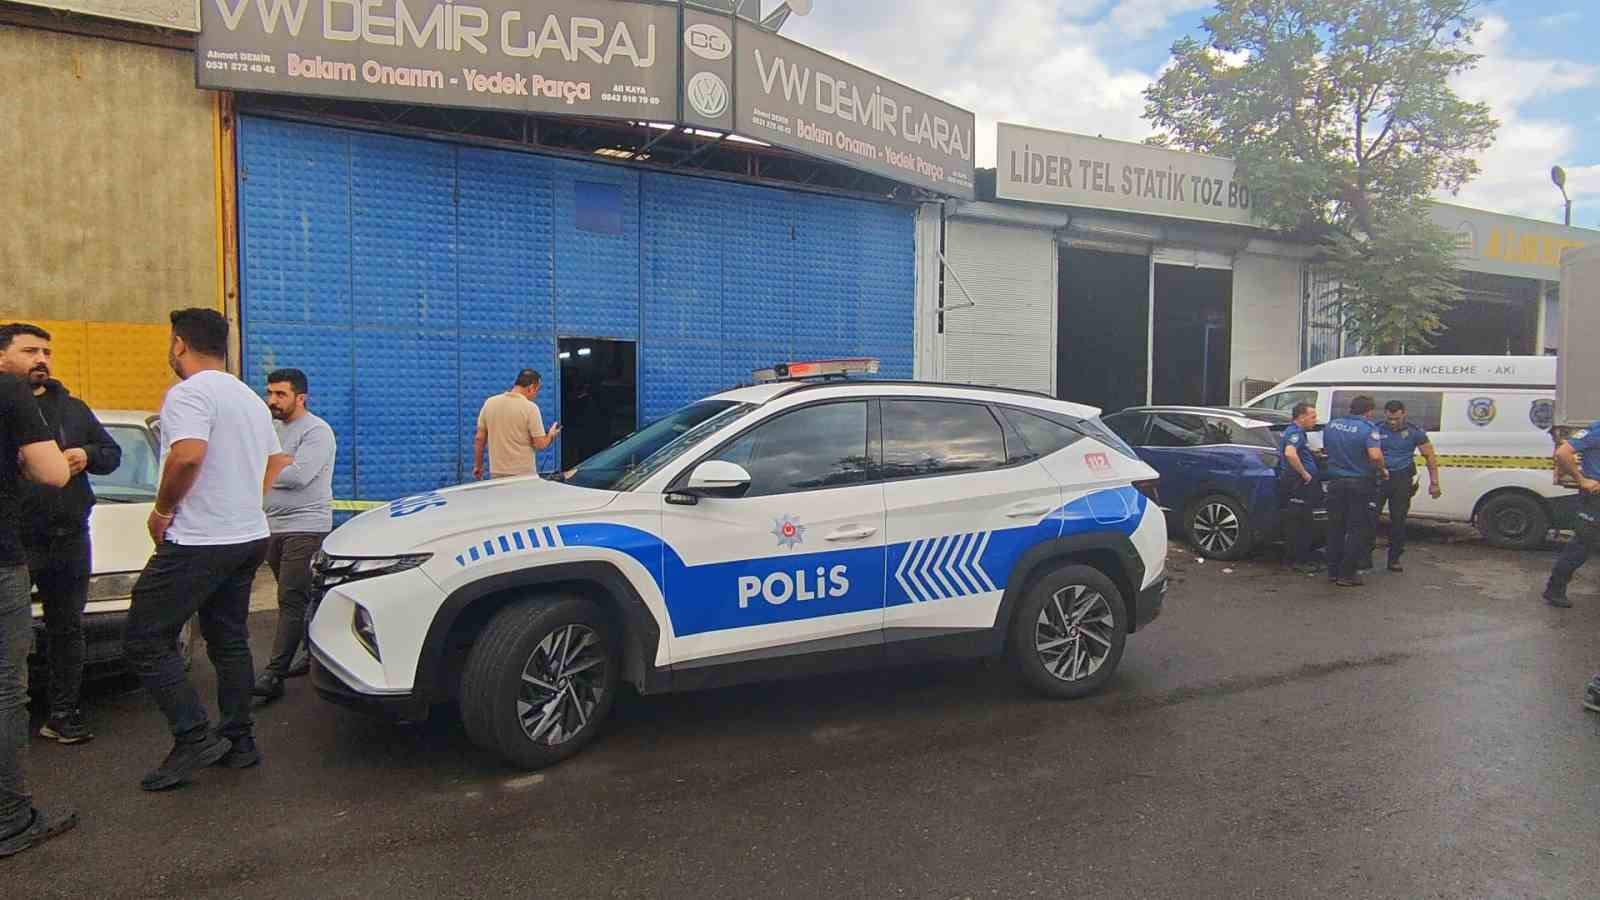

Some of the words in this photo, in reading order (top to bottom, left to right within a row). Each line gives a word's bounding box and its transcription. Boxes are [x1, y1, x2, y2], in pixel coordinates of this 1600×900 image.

[216, 0, 308, 37] VW
[501, 11, 656, 67] GARAJ
[287, 52, 357, 81] Bakım
[362, 60, 444, 88] Onarım
[463, 68, 529, 96] Yedek
[532, 75, 592, 104] Parça
[754, 49, 809, 105] VW
[816, 71, 897, 137] DEMİR
[902, 106, 973, 161] GARAJ
[797, 118, 833, 147] Bakım
[885, 145, 915, 173] Yedek
[916, 156, 944, 182] Parça
[1010, 144, 1073, 188] LİDER
[1079, 159, 1115, 193] TEL
[1121, 164, 1186, 202] STATİK
[1191, 175, 1223, 207] TOZ
[1228, 181, 1252, 210] BO
[1362, 366, 1389, 375] OLAY
